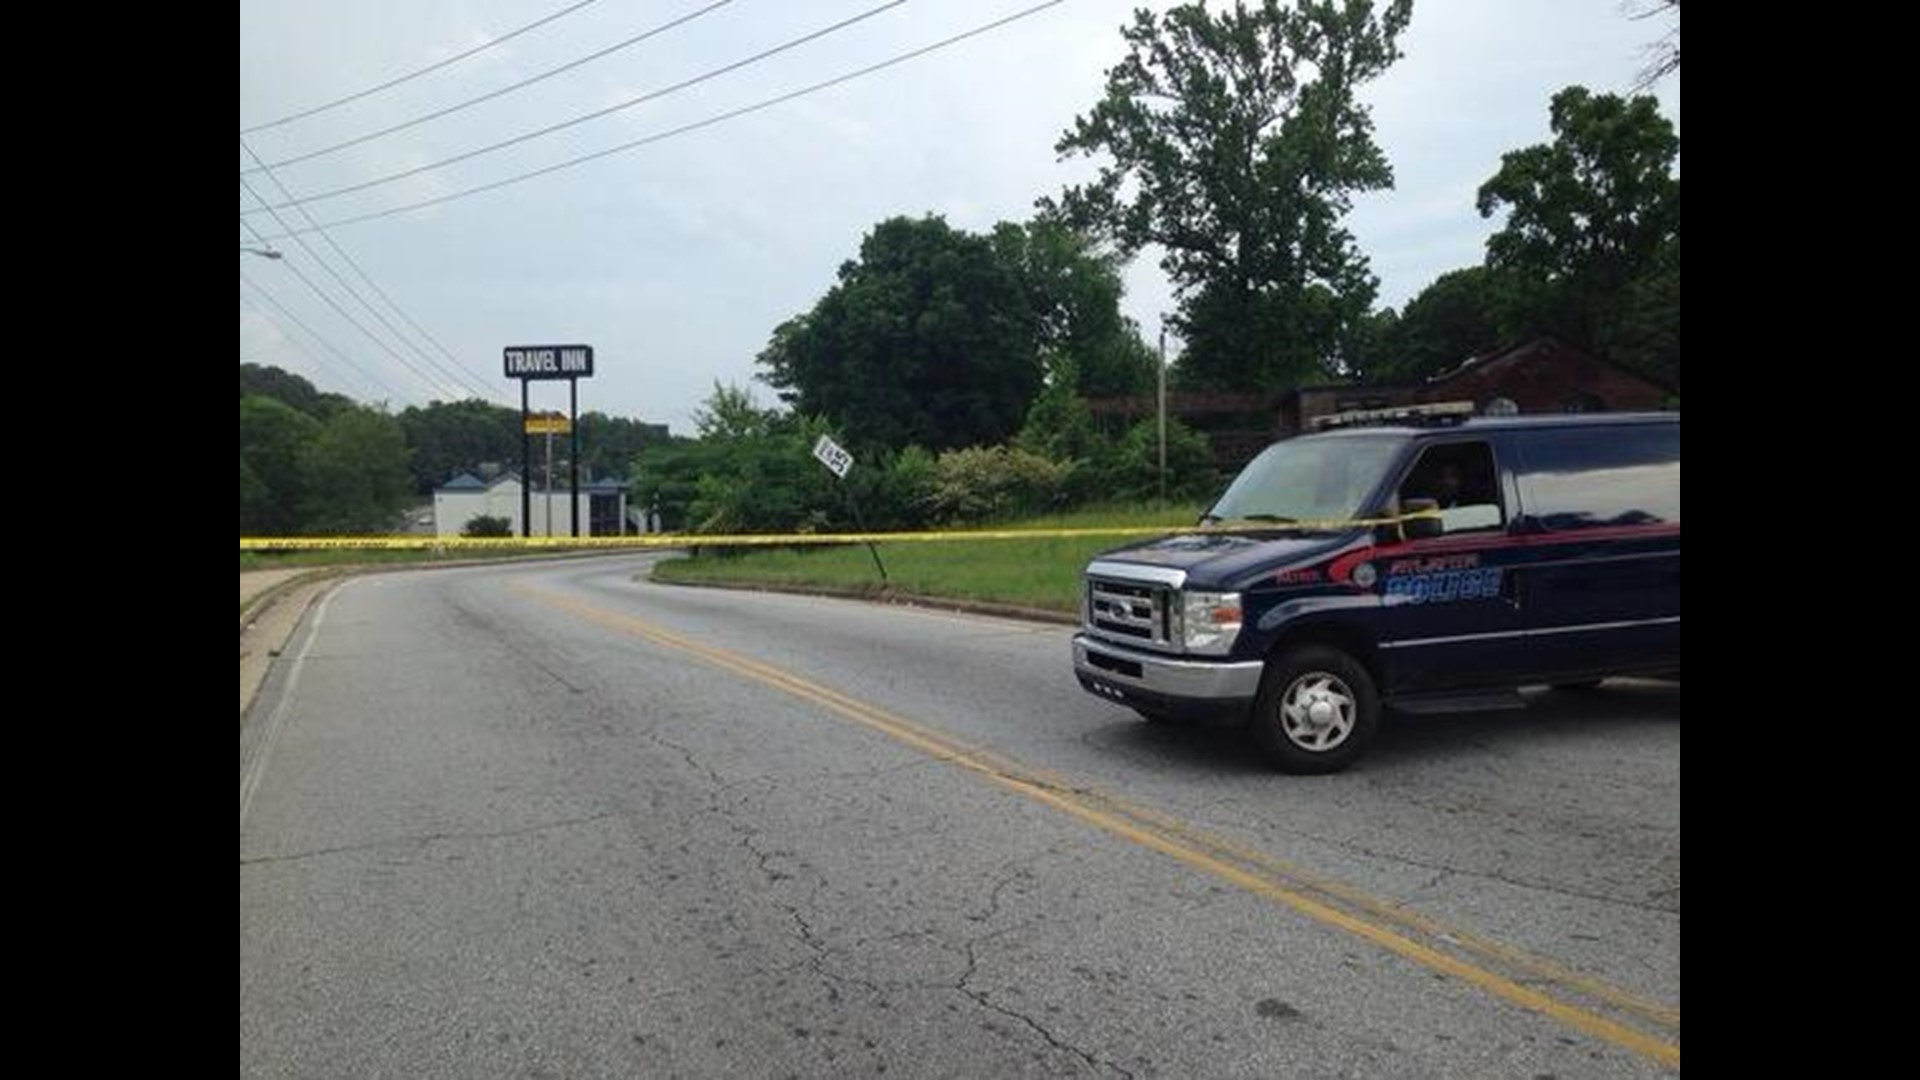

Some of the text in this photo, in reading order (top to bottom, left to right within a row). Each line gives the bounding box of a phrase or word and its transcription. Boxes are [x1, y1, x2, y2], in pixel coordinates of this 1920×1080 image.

[506, 349, 586, 372] TRAVEL INN
[831, 451, 849, 472] 35
[1388, 568, 1499, 603] POLICE
